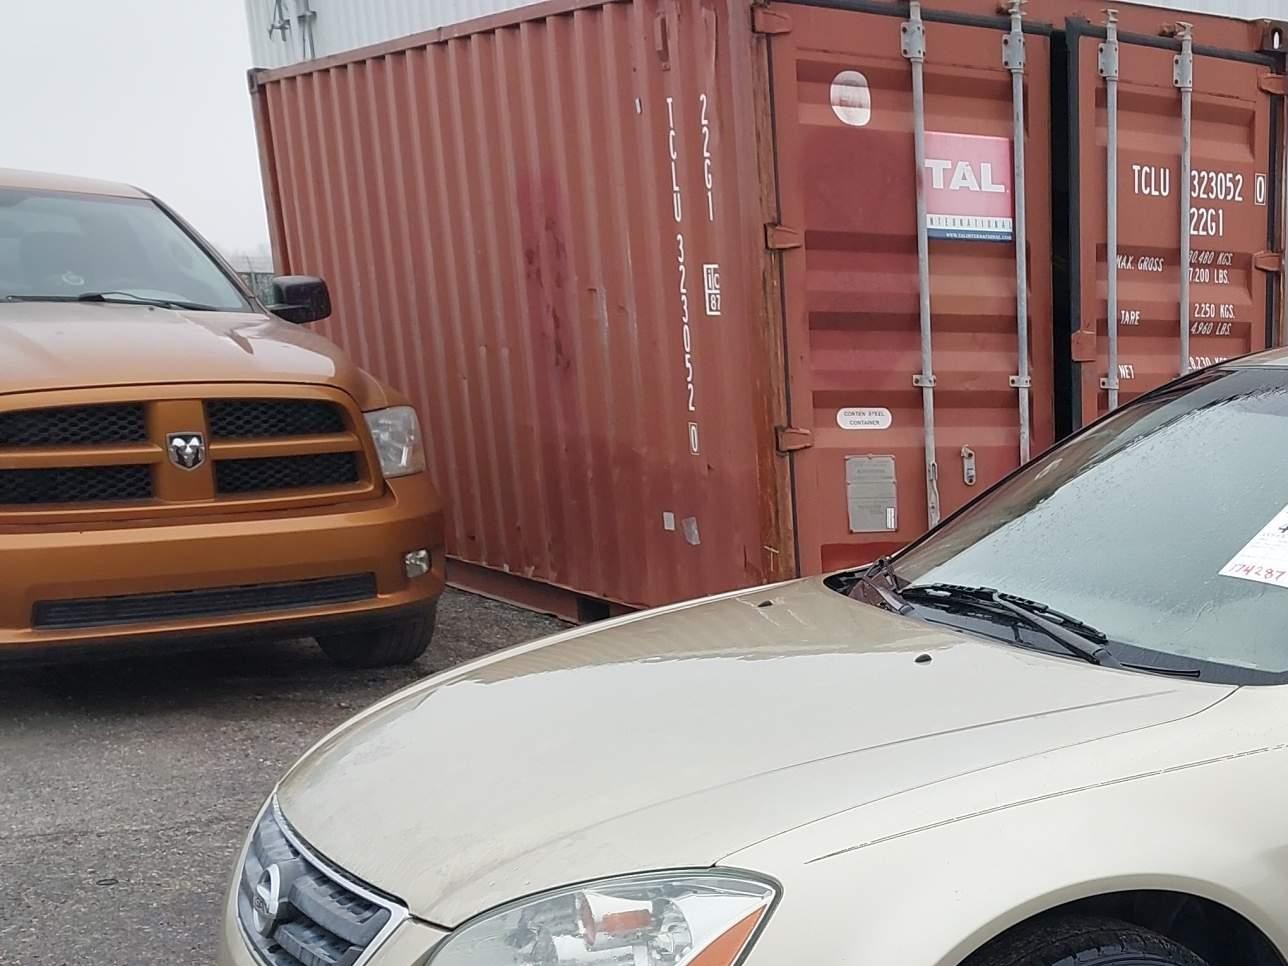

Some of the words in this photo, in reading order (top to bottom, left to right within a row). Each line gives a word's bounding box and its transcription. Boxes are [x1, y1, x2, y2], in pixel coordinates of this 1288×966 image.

[700, 93, 714, 221] 22G1
[925, 159, 1006, 193] TAL
[1132, 165, 1170, 196] TCLU
[1191, 170, 1244, 201] 323052
[1256, 175, 1265, 203] 0
[929, 216, 1012, 229] NTERNATIONAL
[1190, 207, 1224, 236] 22G1
[666, 97, 681, 222] TCLU
[676, 234, 696, 411] 323052
[1137, 256, 1164, 272] GROSS
[1214, 269, 1230, 284] LBS.
[1120, 310, 1140, 326] TARE
[1194, 303, 1216, 318] 2.250
[1220, 304, 1236, 319] KGS.
[1190, 321, 1214, 335] 4.960
[1118, 365, 1135, 379] NET
[1188, 356, 1211, 371] 8.230
